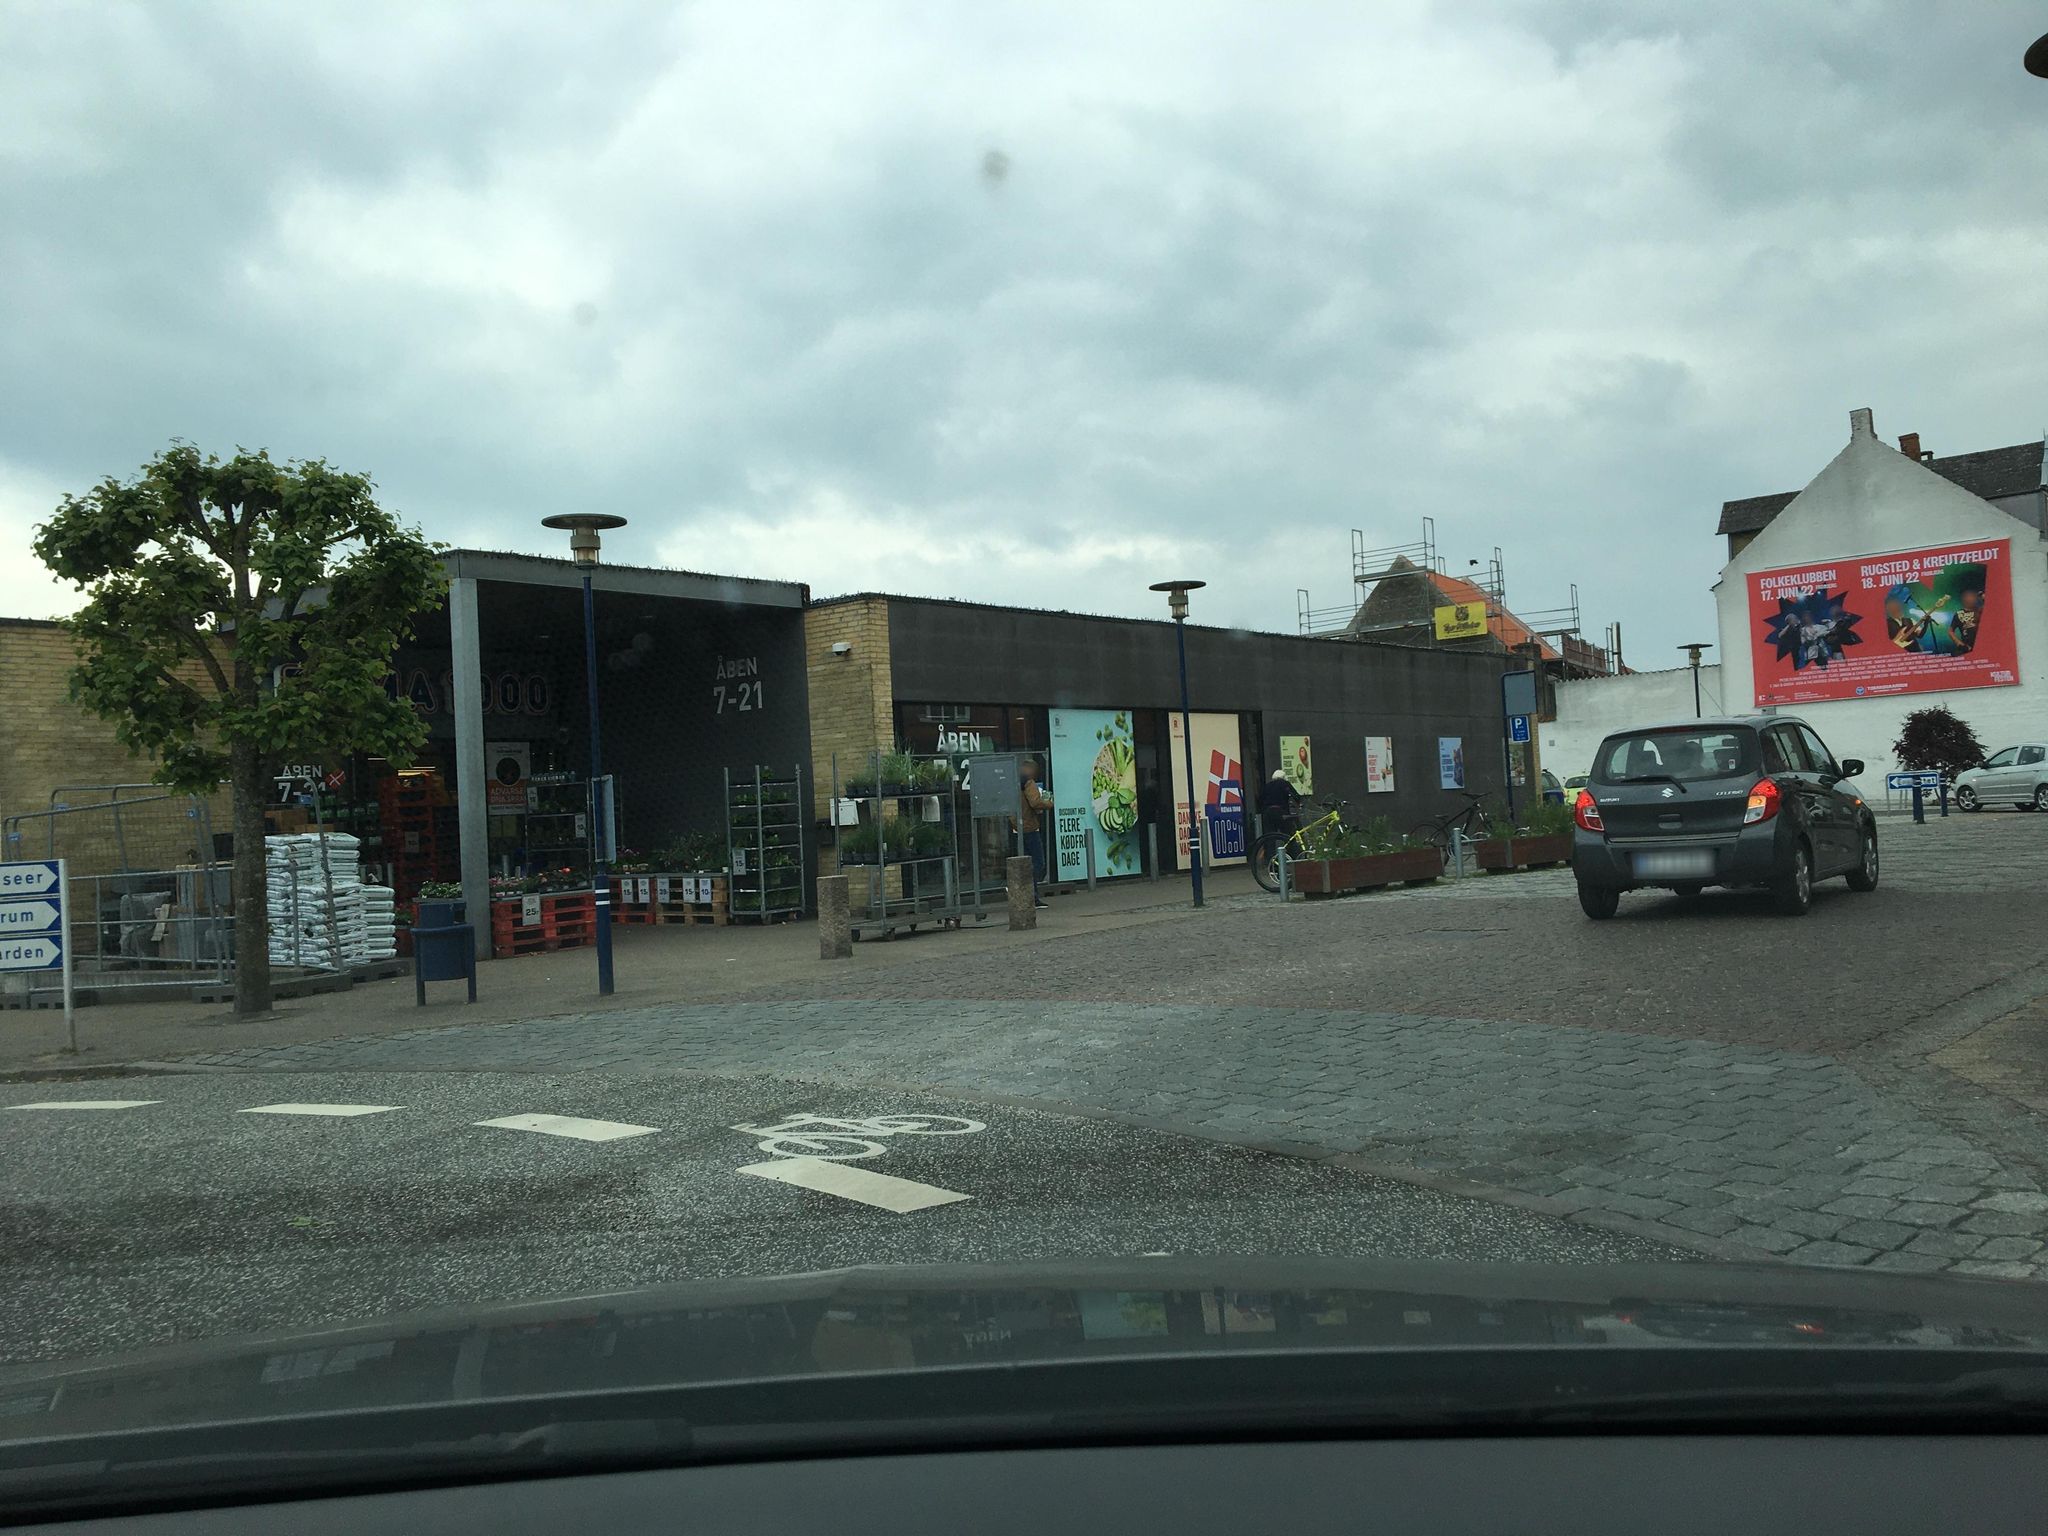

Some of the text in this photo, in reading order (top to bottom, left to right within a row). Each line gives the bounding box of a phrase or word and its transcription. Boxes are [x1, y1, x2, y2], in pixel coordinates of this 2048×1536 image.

[1861, 560, 1910, 577] RUGSTED
[1912, 559, 1921, 569] &
[1923, 548, 1999, 568] KREUTZFELDT
[1760, 569, 1837, 589] FOLKEKLUBBEN
[1861, 577, 1876, 589] 18.
[1879, 574, 1903, 586] JUNI
[1906, 572, 1920, 583] 22
[1761, 590, 1774, 601] 17.
[1776, 587, 1799, 600] JUNI
[1801, 585, 1815, 597] 22
[716, 655, 757, 680] ÅBEN
[713, 681, 763, 714] 7-21
[1514, 718, 1522, 729] P
[937, 724, 980, 752] ÅBEN
[1059, 818, 1081, 833] FLERE
[1061, 851, 1081, 867] DAGE
[3, 873, 43, 886] seer
[0, 946, 43, 960] rden
